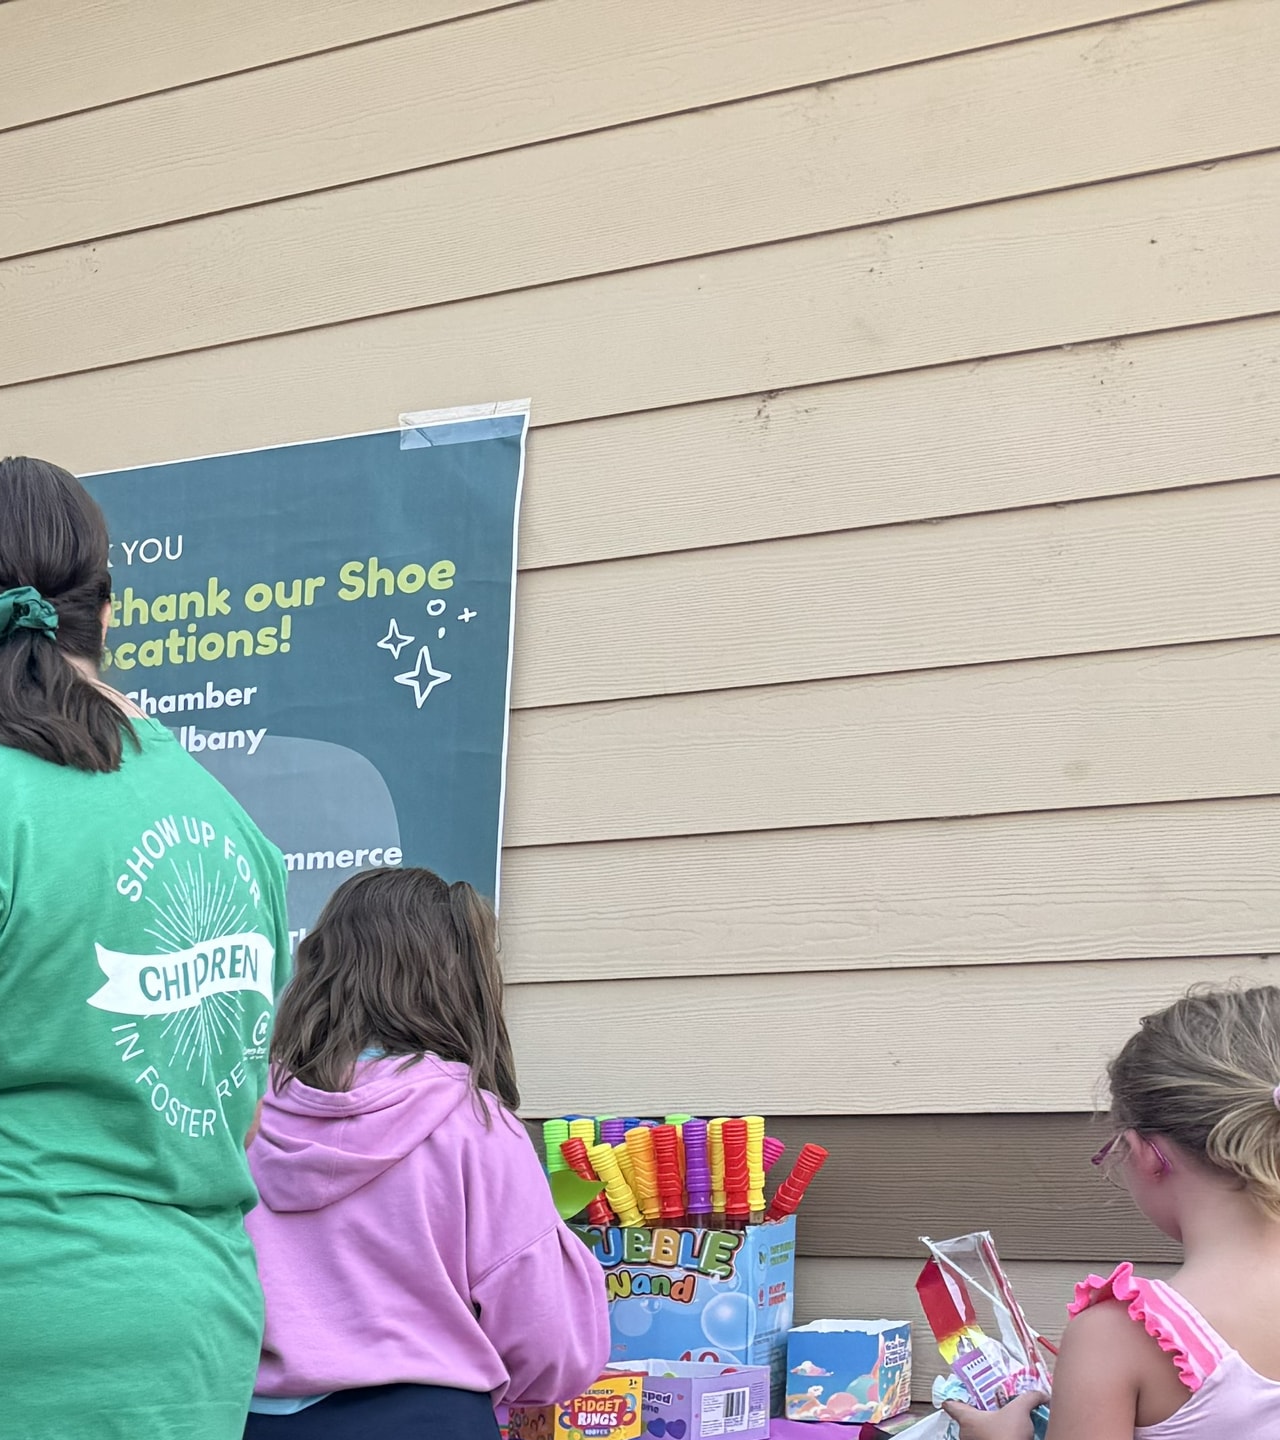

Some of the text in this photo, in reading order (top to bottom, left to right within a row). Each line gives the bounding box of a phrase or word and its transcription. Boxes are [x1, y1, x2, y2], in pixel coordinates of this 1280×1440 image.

[121, 534, 183, 566] YOU
[108, 557, 456, 628] thank our Shoe
[179, 726, 268, 756] lbany
[116, 814, 262, 907] SHOW UP FOR
[283, 846, 403, 872] mmerce
[111, 1022, 145, 1063] IN
[135, 1065, 217, 1139] FOSTER
[590, 1226, 741, 1280] UBBLE
[573, 1398, 624, 1413] FIDGET
[577, 1412, 618, 1427] RINGS
